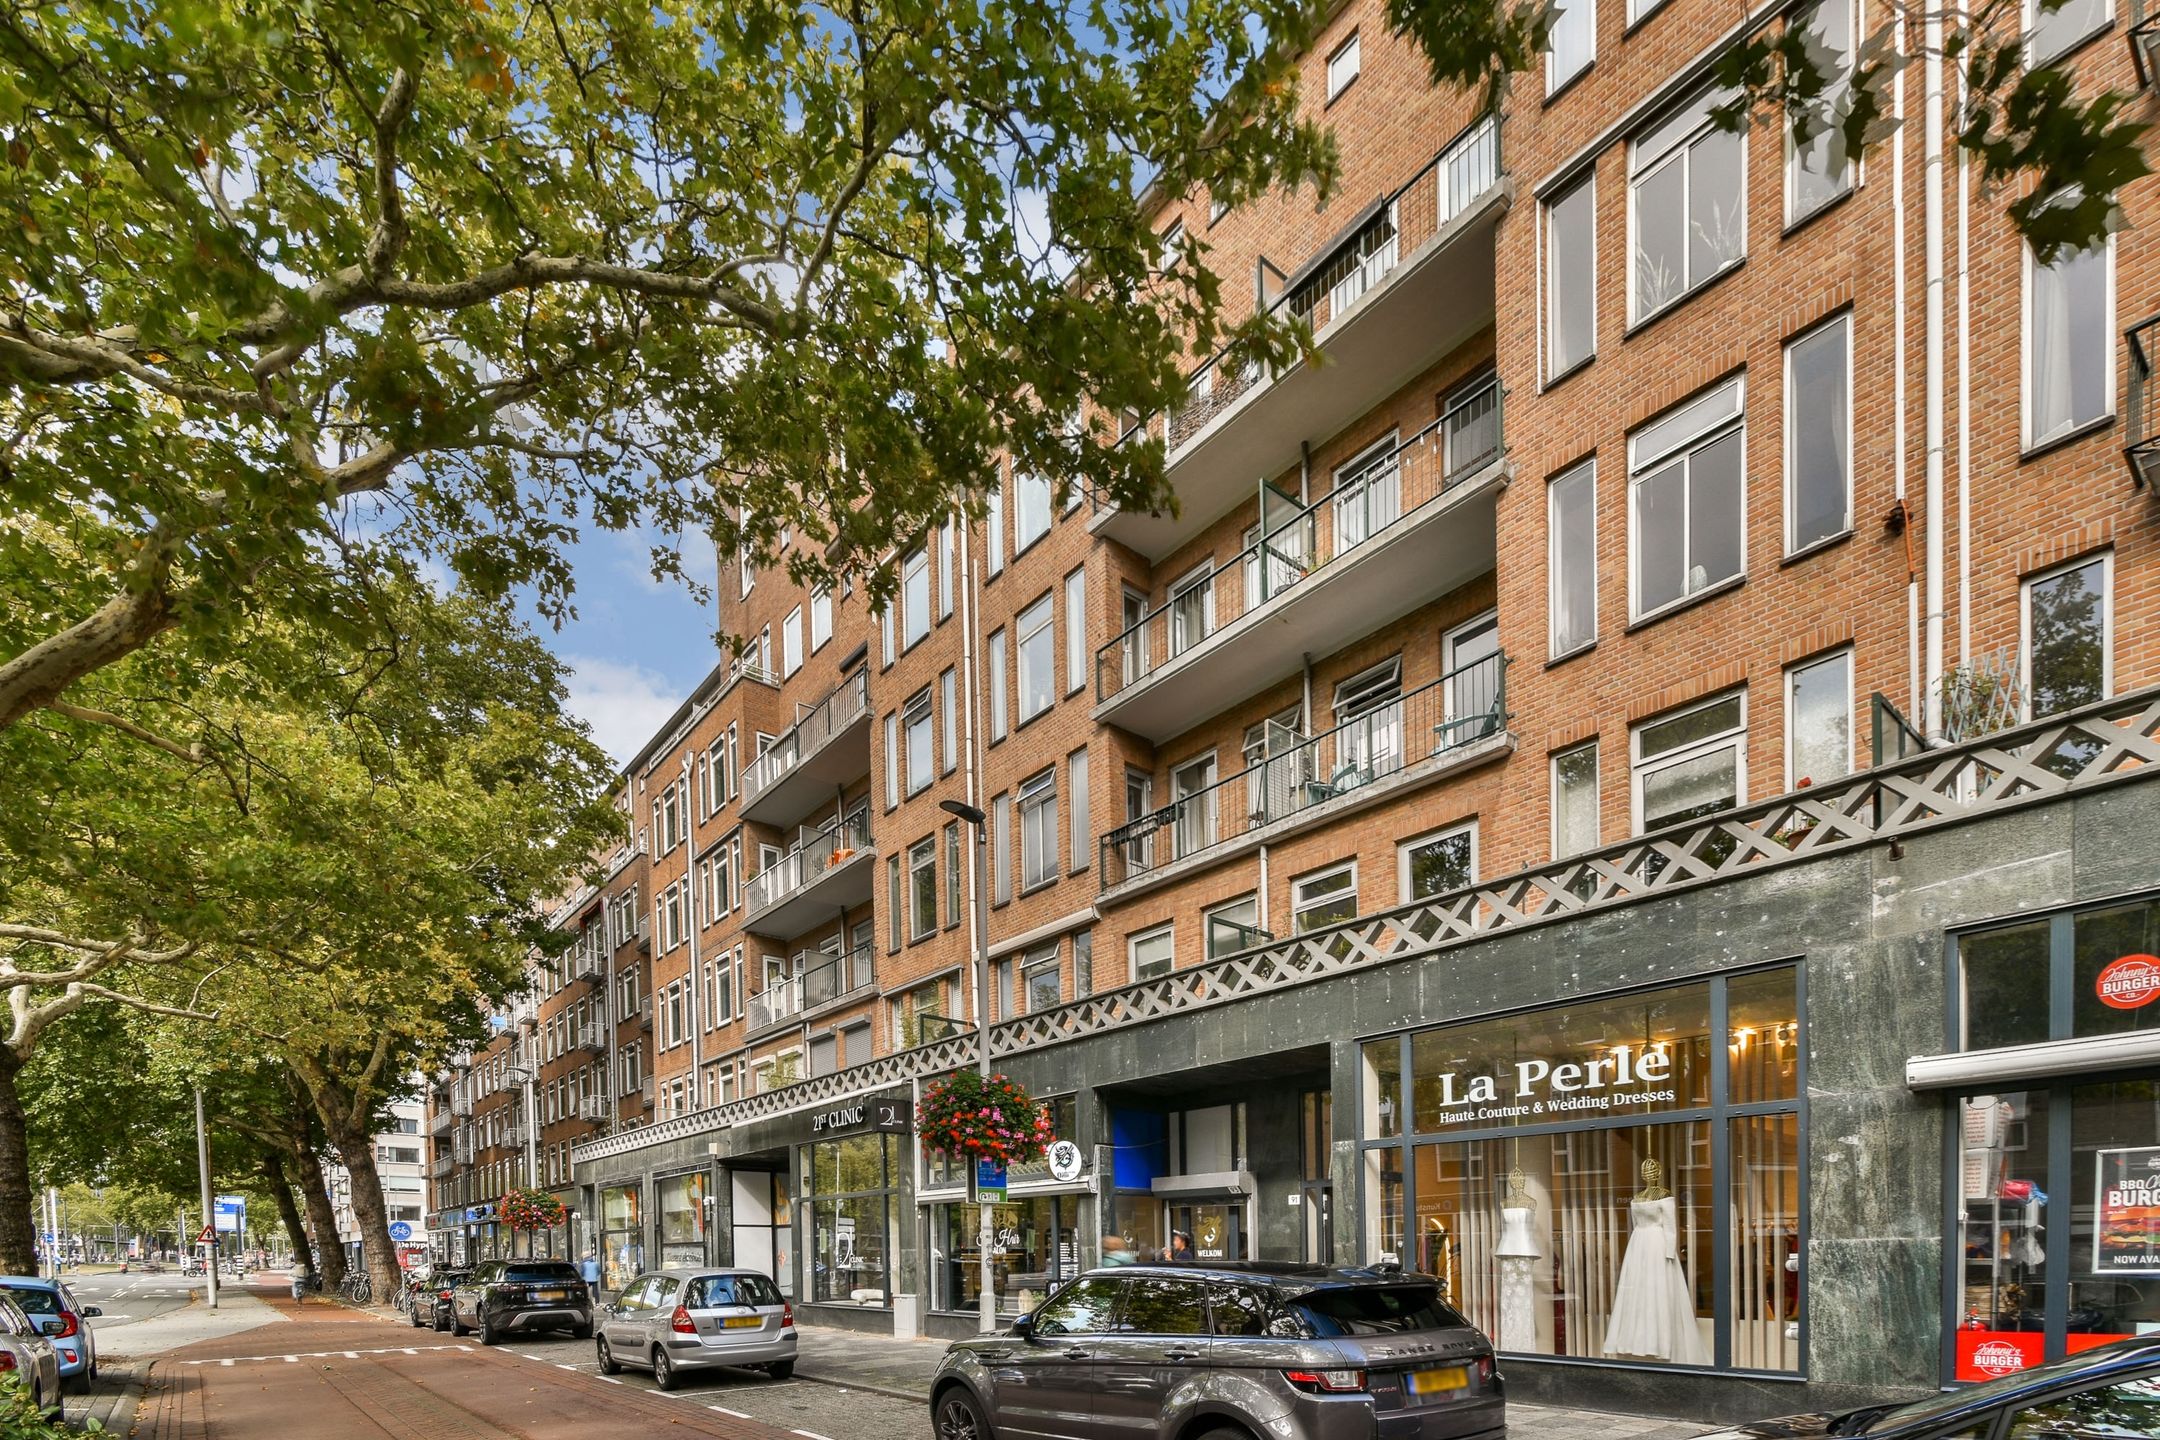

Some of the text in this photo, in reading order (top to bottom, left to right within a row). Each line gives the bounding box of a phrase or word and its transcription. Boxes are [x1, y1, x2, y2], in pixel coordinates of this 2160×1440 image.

[2103, 975, 2160, 994] BURGER
[1438, 1045, 1671, 1107] La Perle
[1439, 1088, 1675, 1124] Haute Couture & Wedding Dresses
[828, 1106, 864, 1129] CLINIC
[2119, 1180, 2145, 1190] BBQ
[993, 1227, 1020, 1248] Hair
[1197, 1249, 1223, 1257] WELKOM
[2113, 1255, 2138, 1264] NOW
[1974, 1355, 2022, 1367] BURGER
